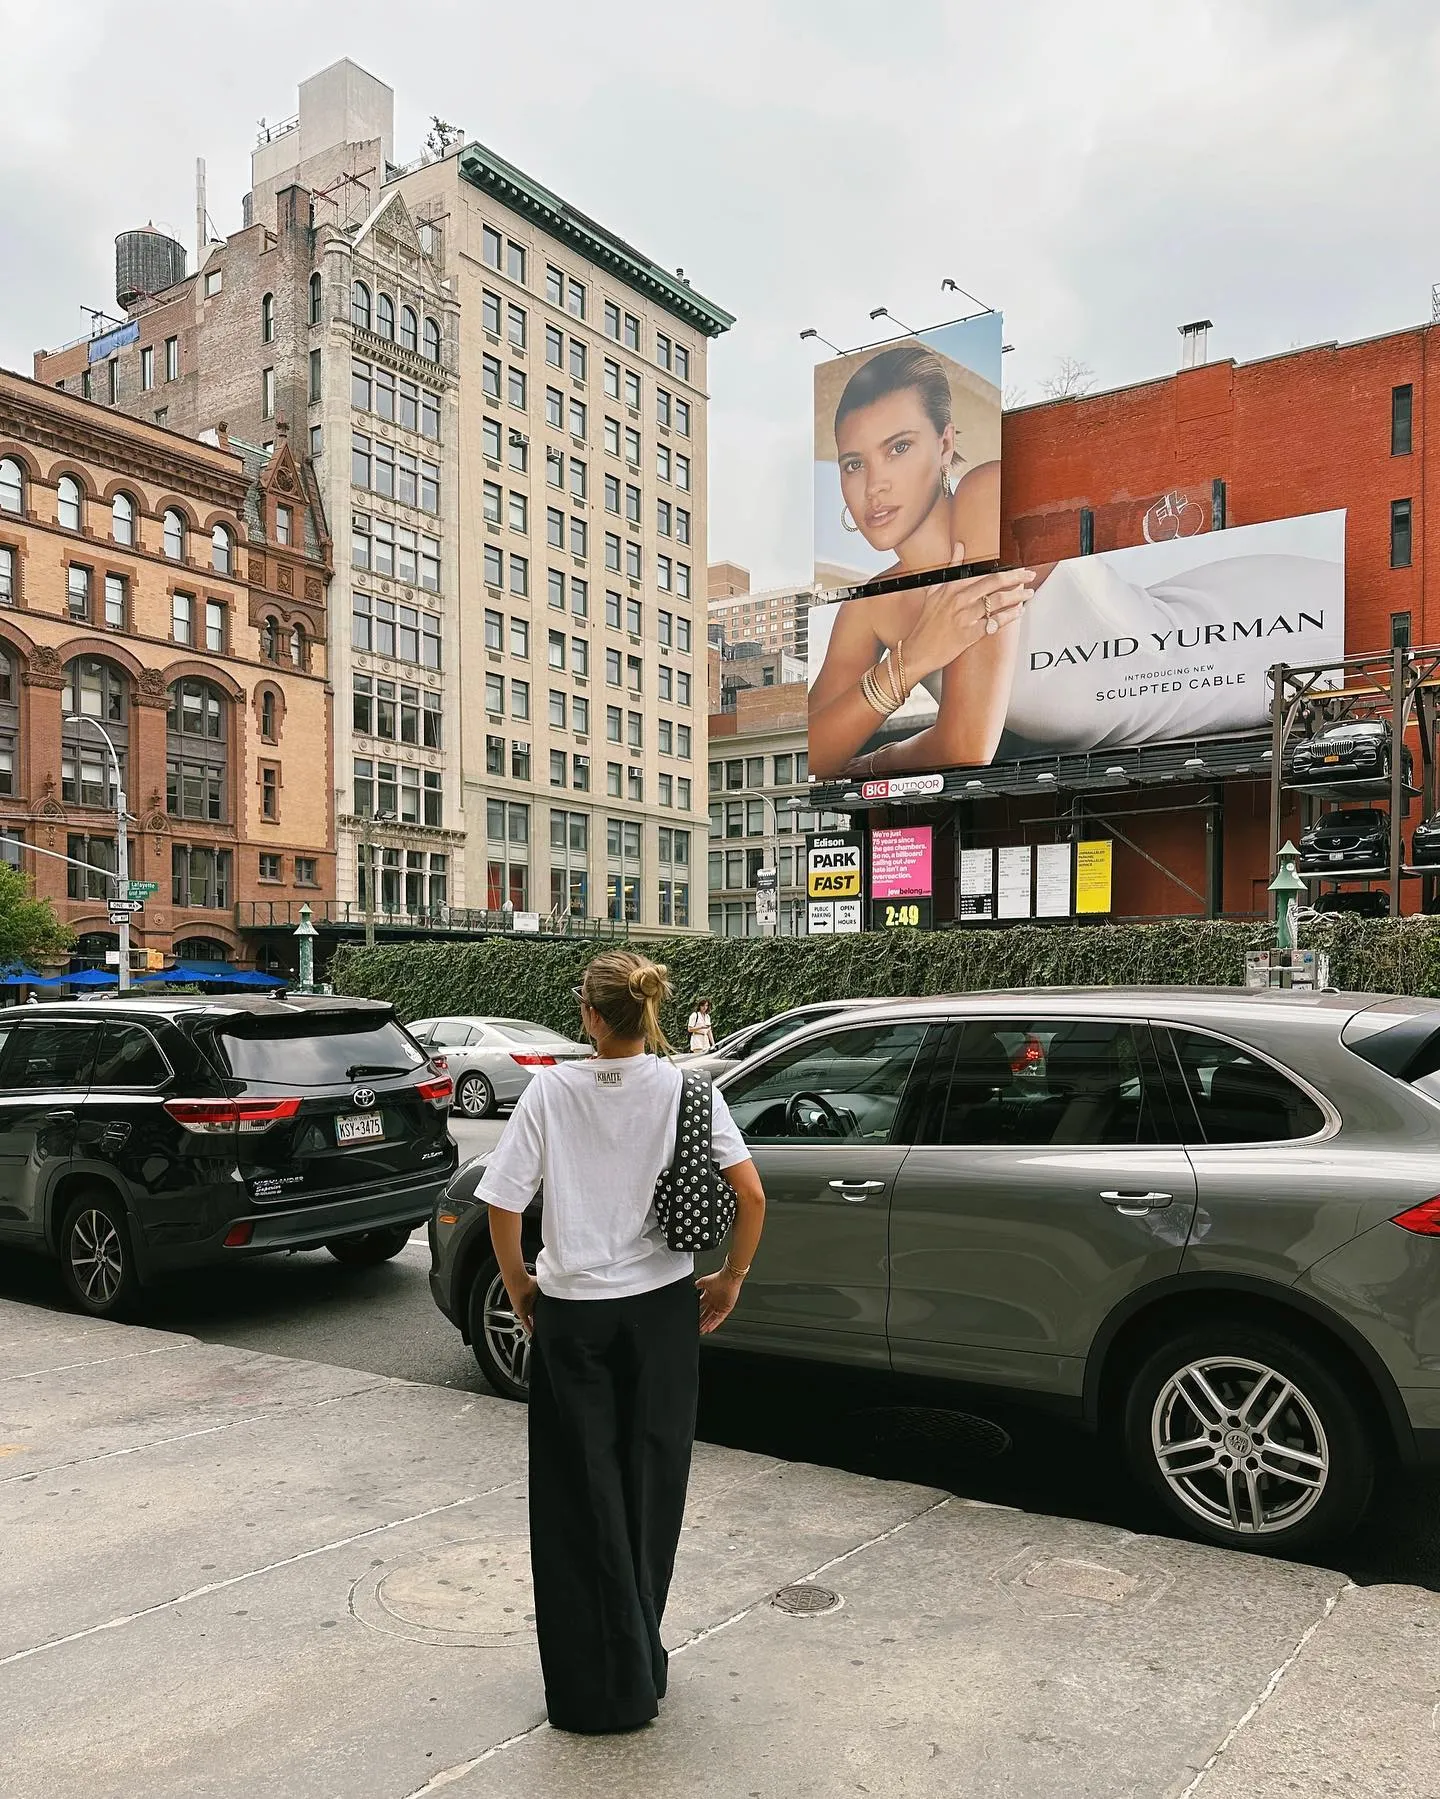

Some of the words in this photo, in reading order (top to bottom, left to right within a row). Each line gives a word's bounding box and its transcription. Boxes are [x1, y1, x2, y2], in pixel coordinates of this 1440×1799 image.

[1030, 637, 1139, 671] DAVID
[1150, 610, 1324, 651] YURMAN
[1124, 667, 1190, 681] INTRODUCING
[1193, 664, 1215, 673] NEW
[1096, 681, 1182, 701] SCULPTED
[1188, 673, 1246, 691] CABLE
[866, 783, 886, 797] BIG
[890, 780, 939, 792] OUTDOOR
[890, 830, 902, 838] just
[814, 838, 844, 847] Edison
[813, 852, 856, 868] PARK
[896, 850, 923, 858] billboard
[813, 875, 855, 891] FAST
[885, 904, 919, 926] 2:49
[597, 1072, 622, 1081] KHAITE
